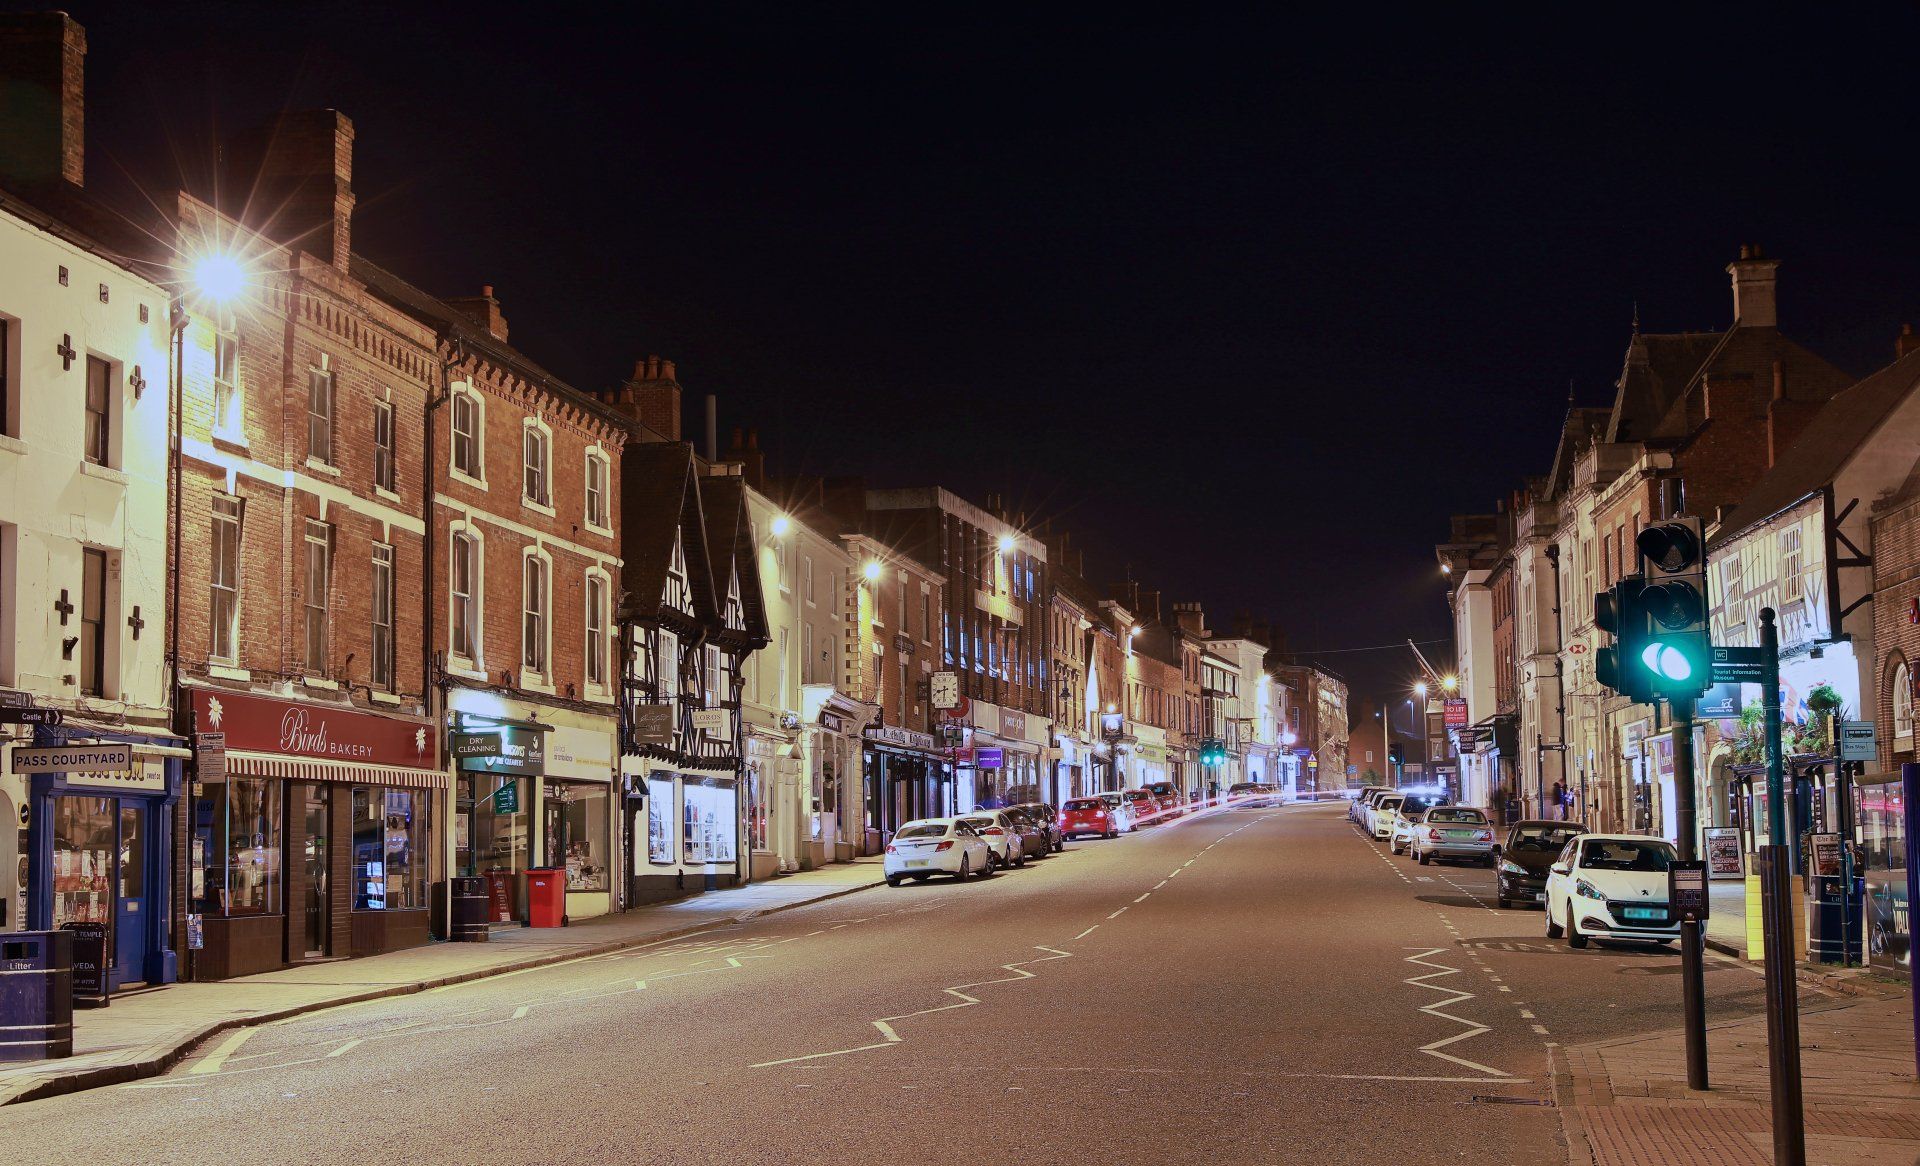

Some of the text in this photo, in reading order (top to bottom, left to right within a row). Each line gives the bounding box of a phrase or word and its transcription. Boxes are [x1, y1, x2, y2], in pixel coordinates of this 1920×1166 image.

[22, 712, 42, 721] Castle
[824, 713, 839, 730] PINK
[280, 707, 373, 757] Birds BAKERY
[469, 737, 484, 745] DRY
[458, 745, 496, 753] CLEANING
[16, 753, 125, 766] PASS COURTYARD
[9, 962, 32, 970] Litter
[72, 962, 95, 970] VEDA
